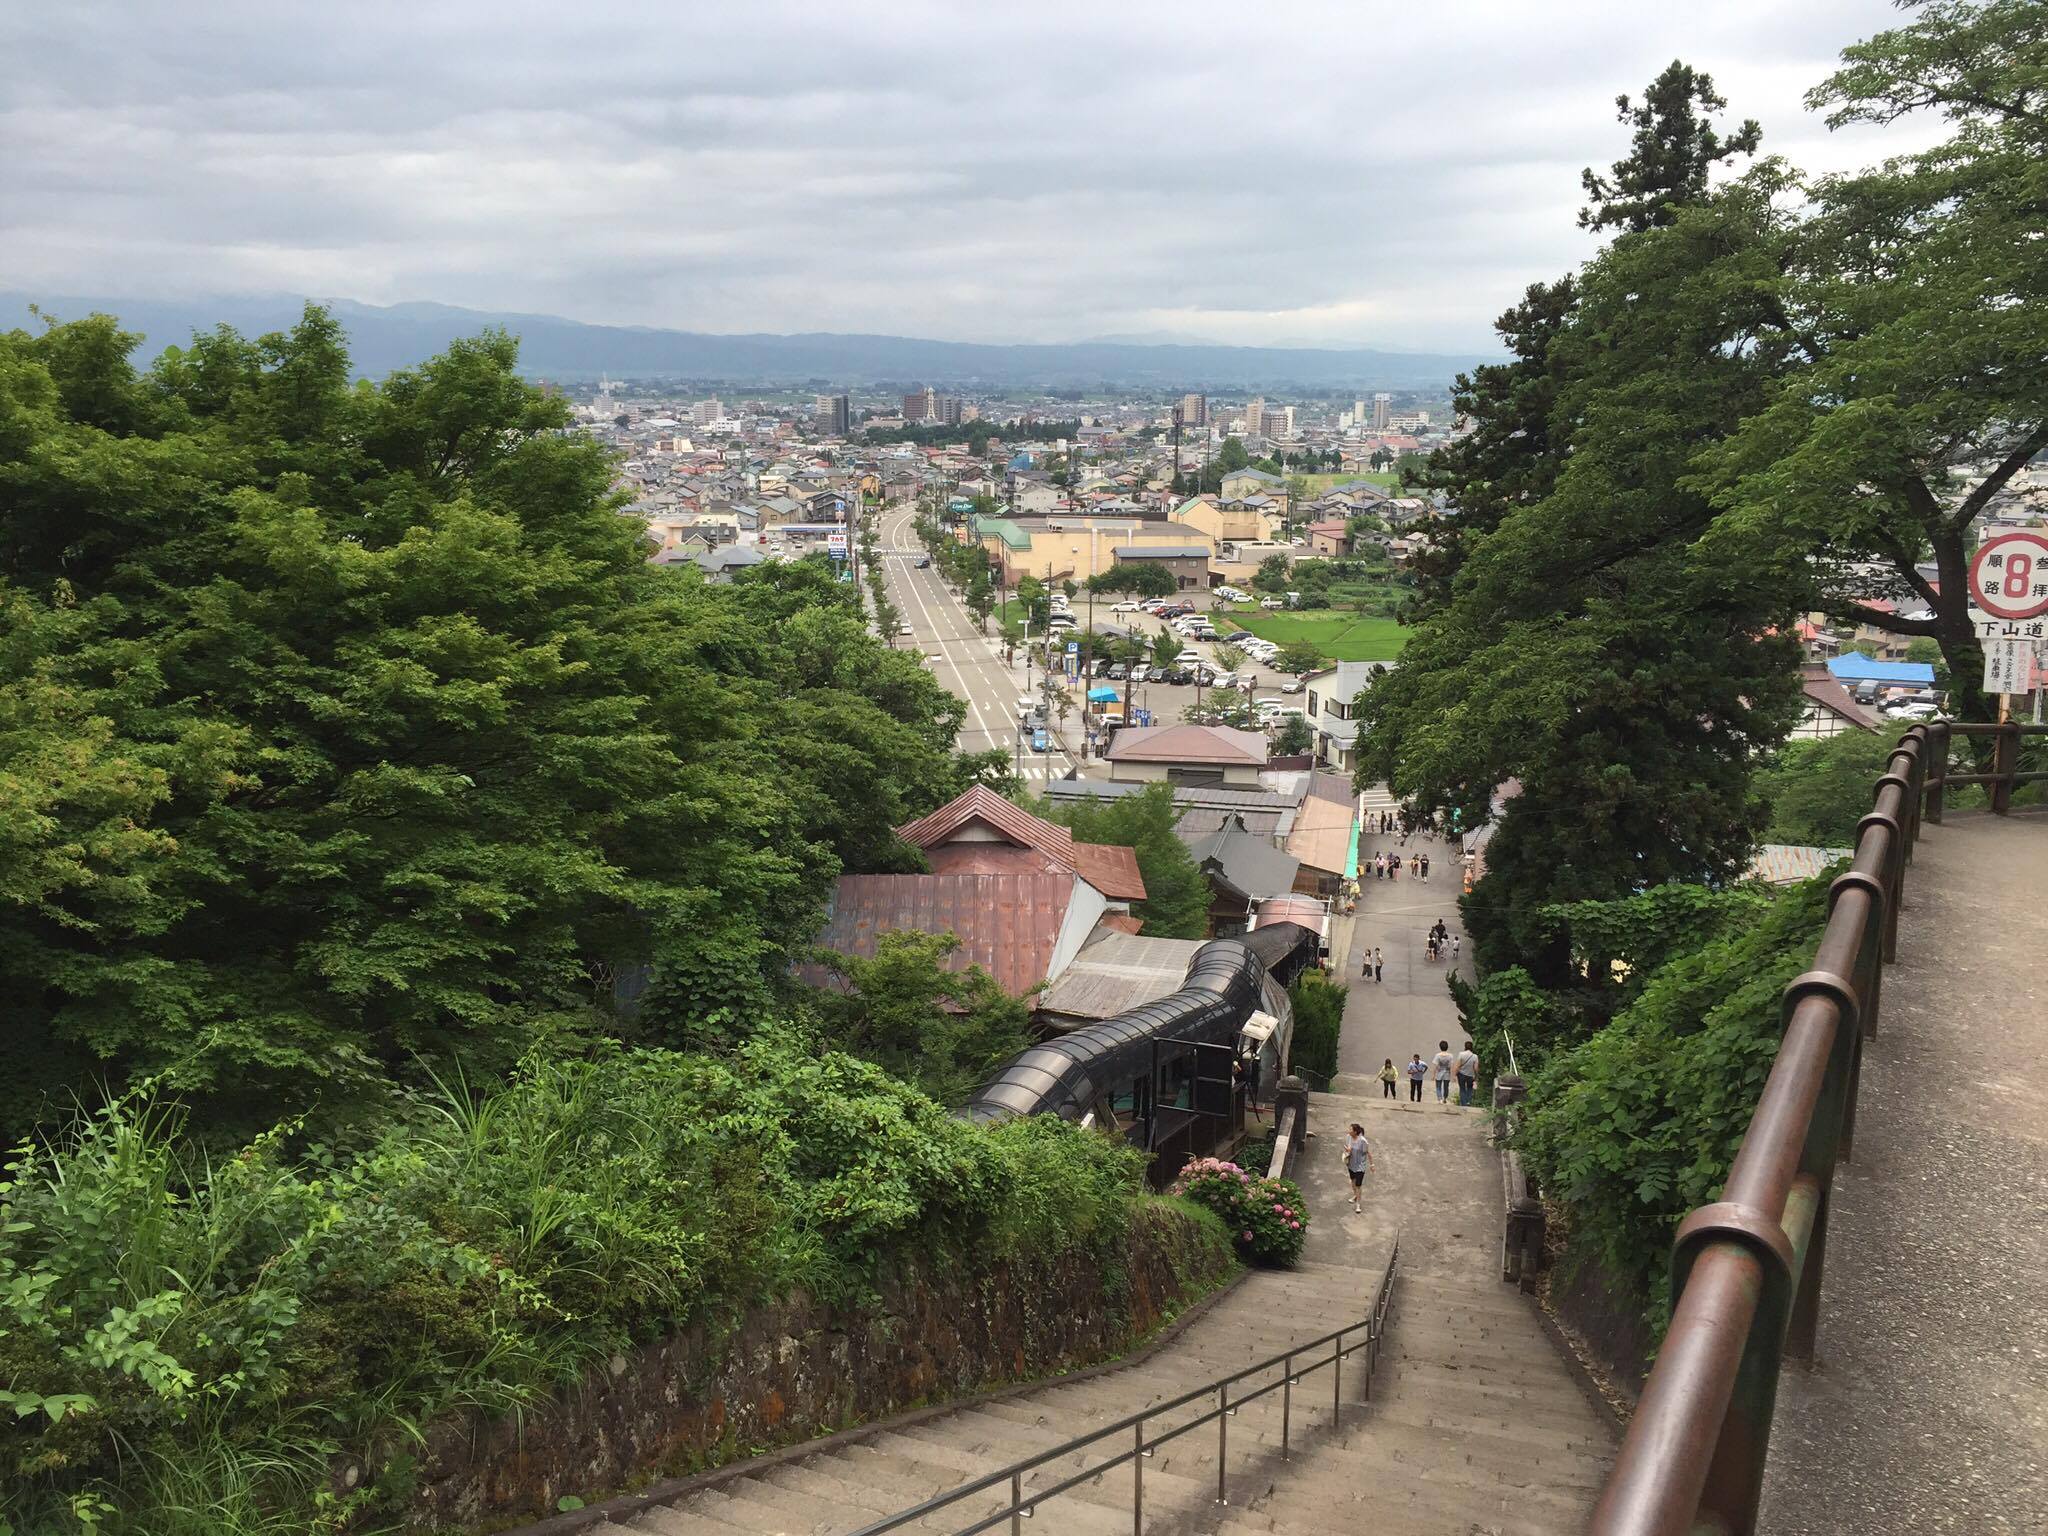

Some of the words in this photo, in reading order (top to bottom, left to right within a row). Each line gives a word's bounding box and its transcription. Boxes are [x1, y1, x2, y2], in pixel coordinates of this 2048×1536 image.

[1984, 554, 2003, 595] 順路
[2004, 553, 2032, 598] 8
[1980, 621, 2043, 638] 下山道
